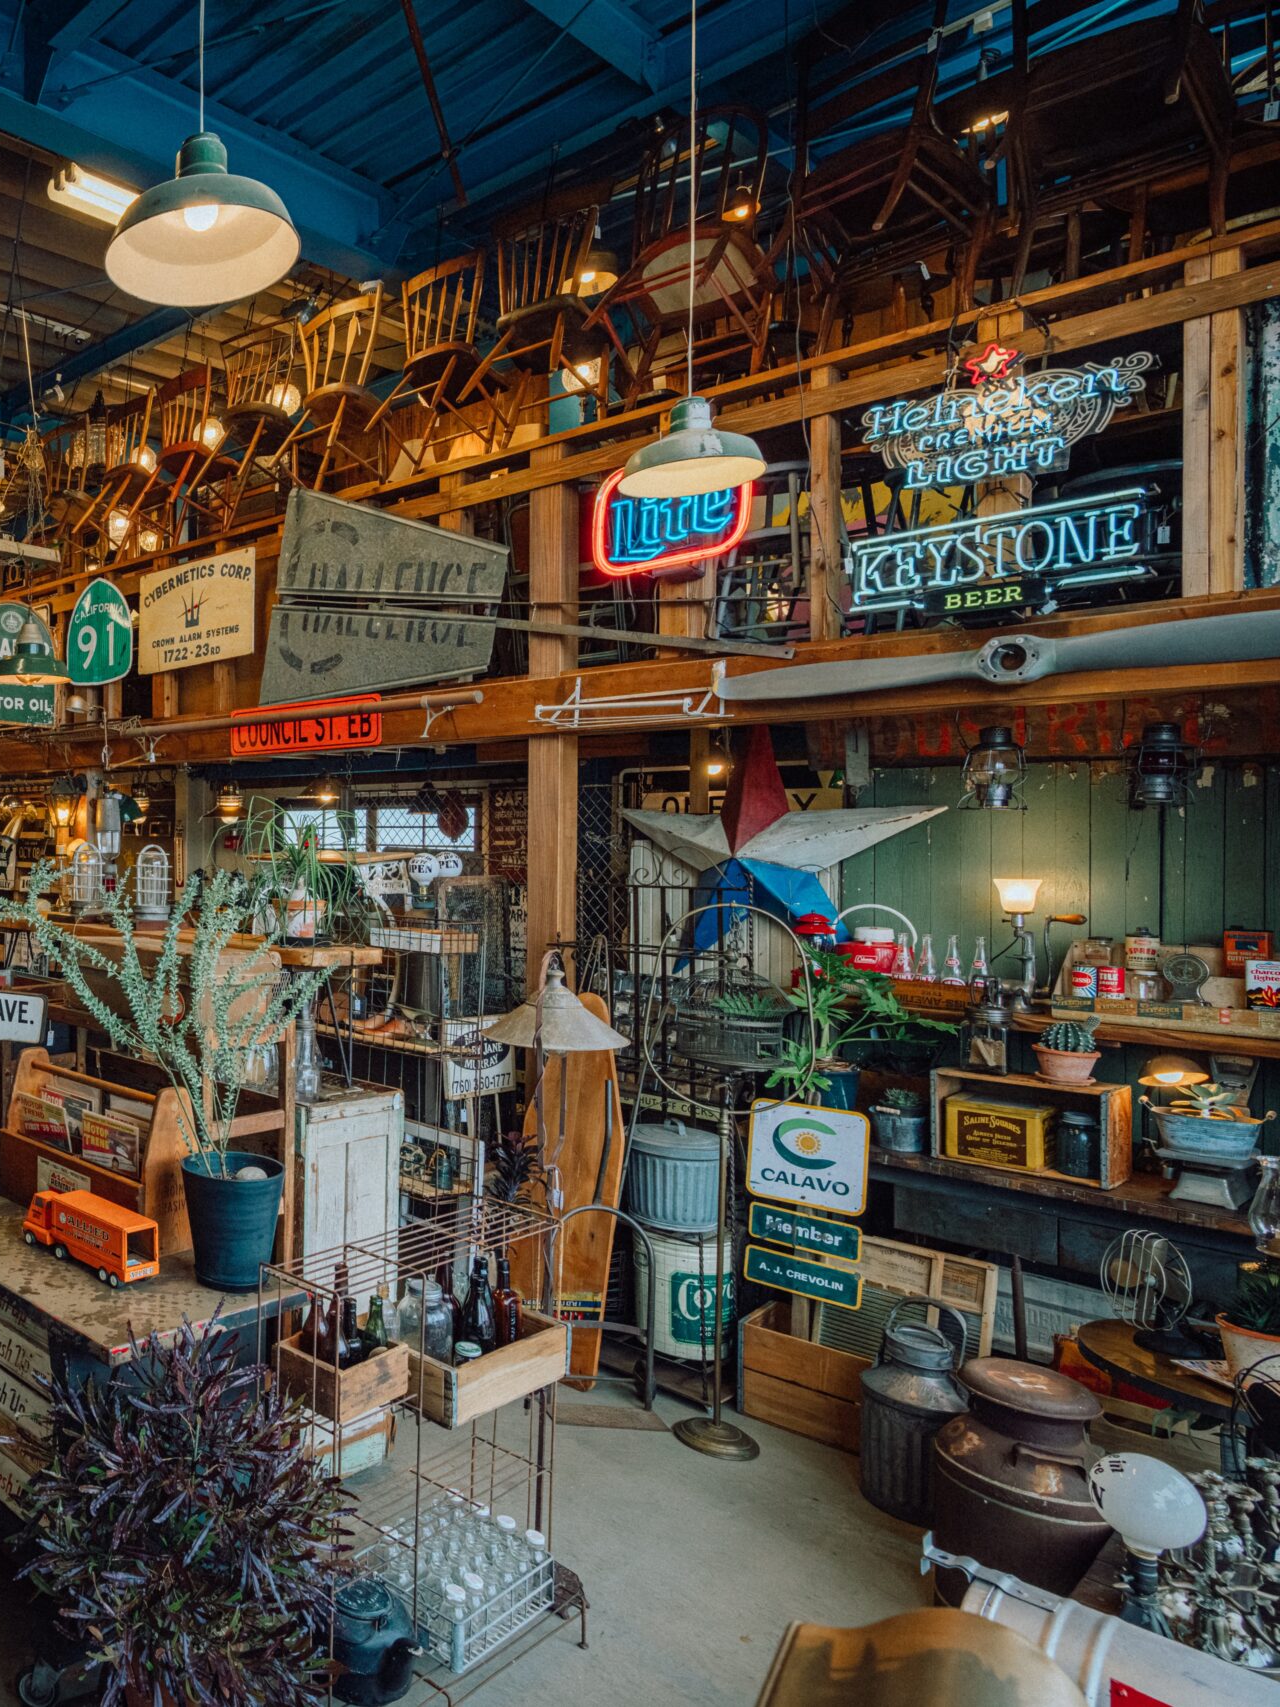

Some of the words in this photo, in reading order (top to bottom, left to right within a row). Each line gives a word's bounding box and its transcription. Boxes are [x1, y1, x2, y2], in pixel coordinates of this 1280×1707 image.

[867, 368, 1128, 440] Heineken
[919, 413, 1053, 450] PREMIUM
[904, 438, 1065, 489] LIGHT
[854, 503, 1140, 598] KEYSTONE
[144, 564, 215, 608] CYBERNETICS
[220, 563, 252, 581] CORP.
[944, 586, 1023, 610] BEER
[74, 602, 124, 624] CALIFORNIA
[77, 621, 116, 670] 91
[152, 637, 175, 648] CROWN
[179, 632, 202, 643] ALARM
[206, 624, 240, 639] SYSTEMS
[29, 699, 55, 713] OIL
[348, 711, 372, 738] EB
[439, 860, 459, 869] PEN
[483, 1042, 504, 1056] JANE
[452, 1079, 472, 1095] (760)
[760, 1167, 850, 1196] CALAVO
[67, 1214, 110, 1242] ALLIED
[764, 1214, 843, 1247] Member
[758, 1261, 771, 1271] A.
[773, 1266, 783, 1275] J.
[786, 1269, 844, 1292] CREVOLIN
